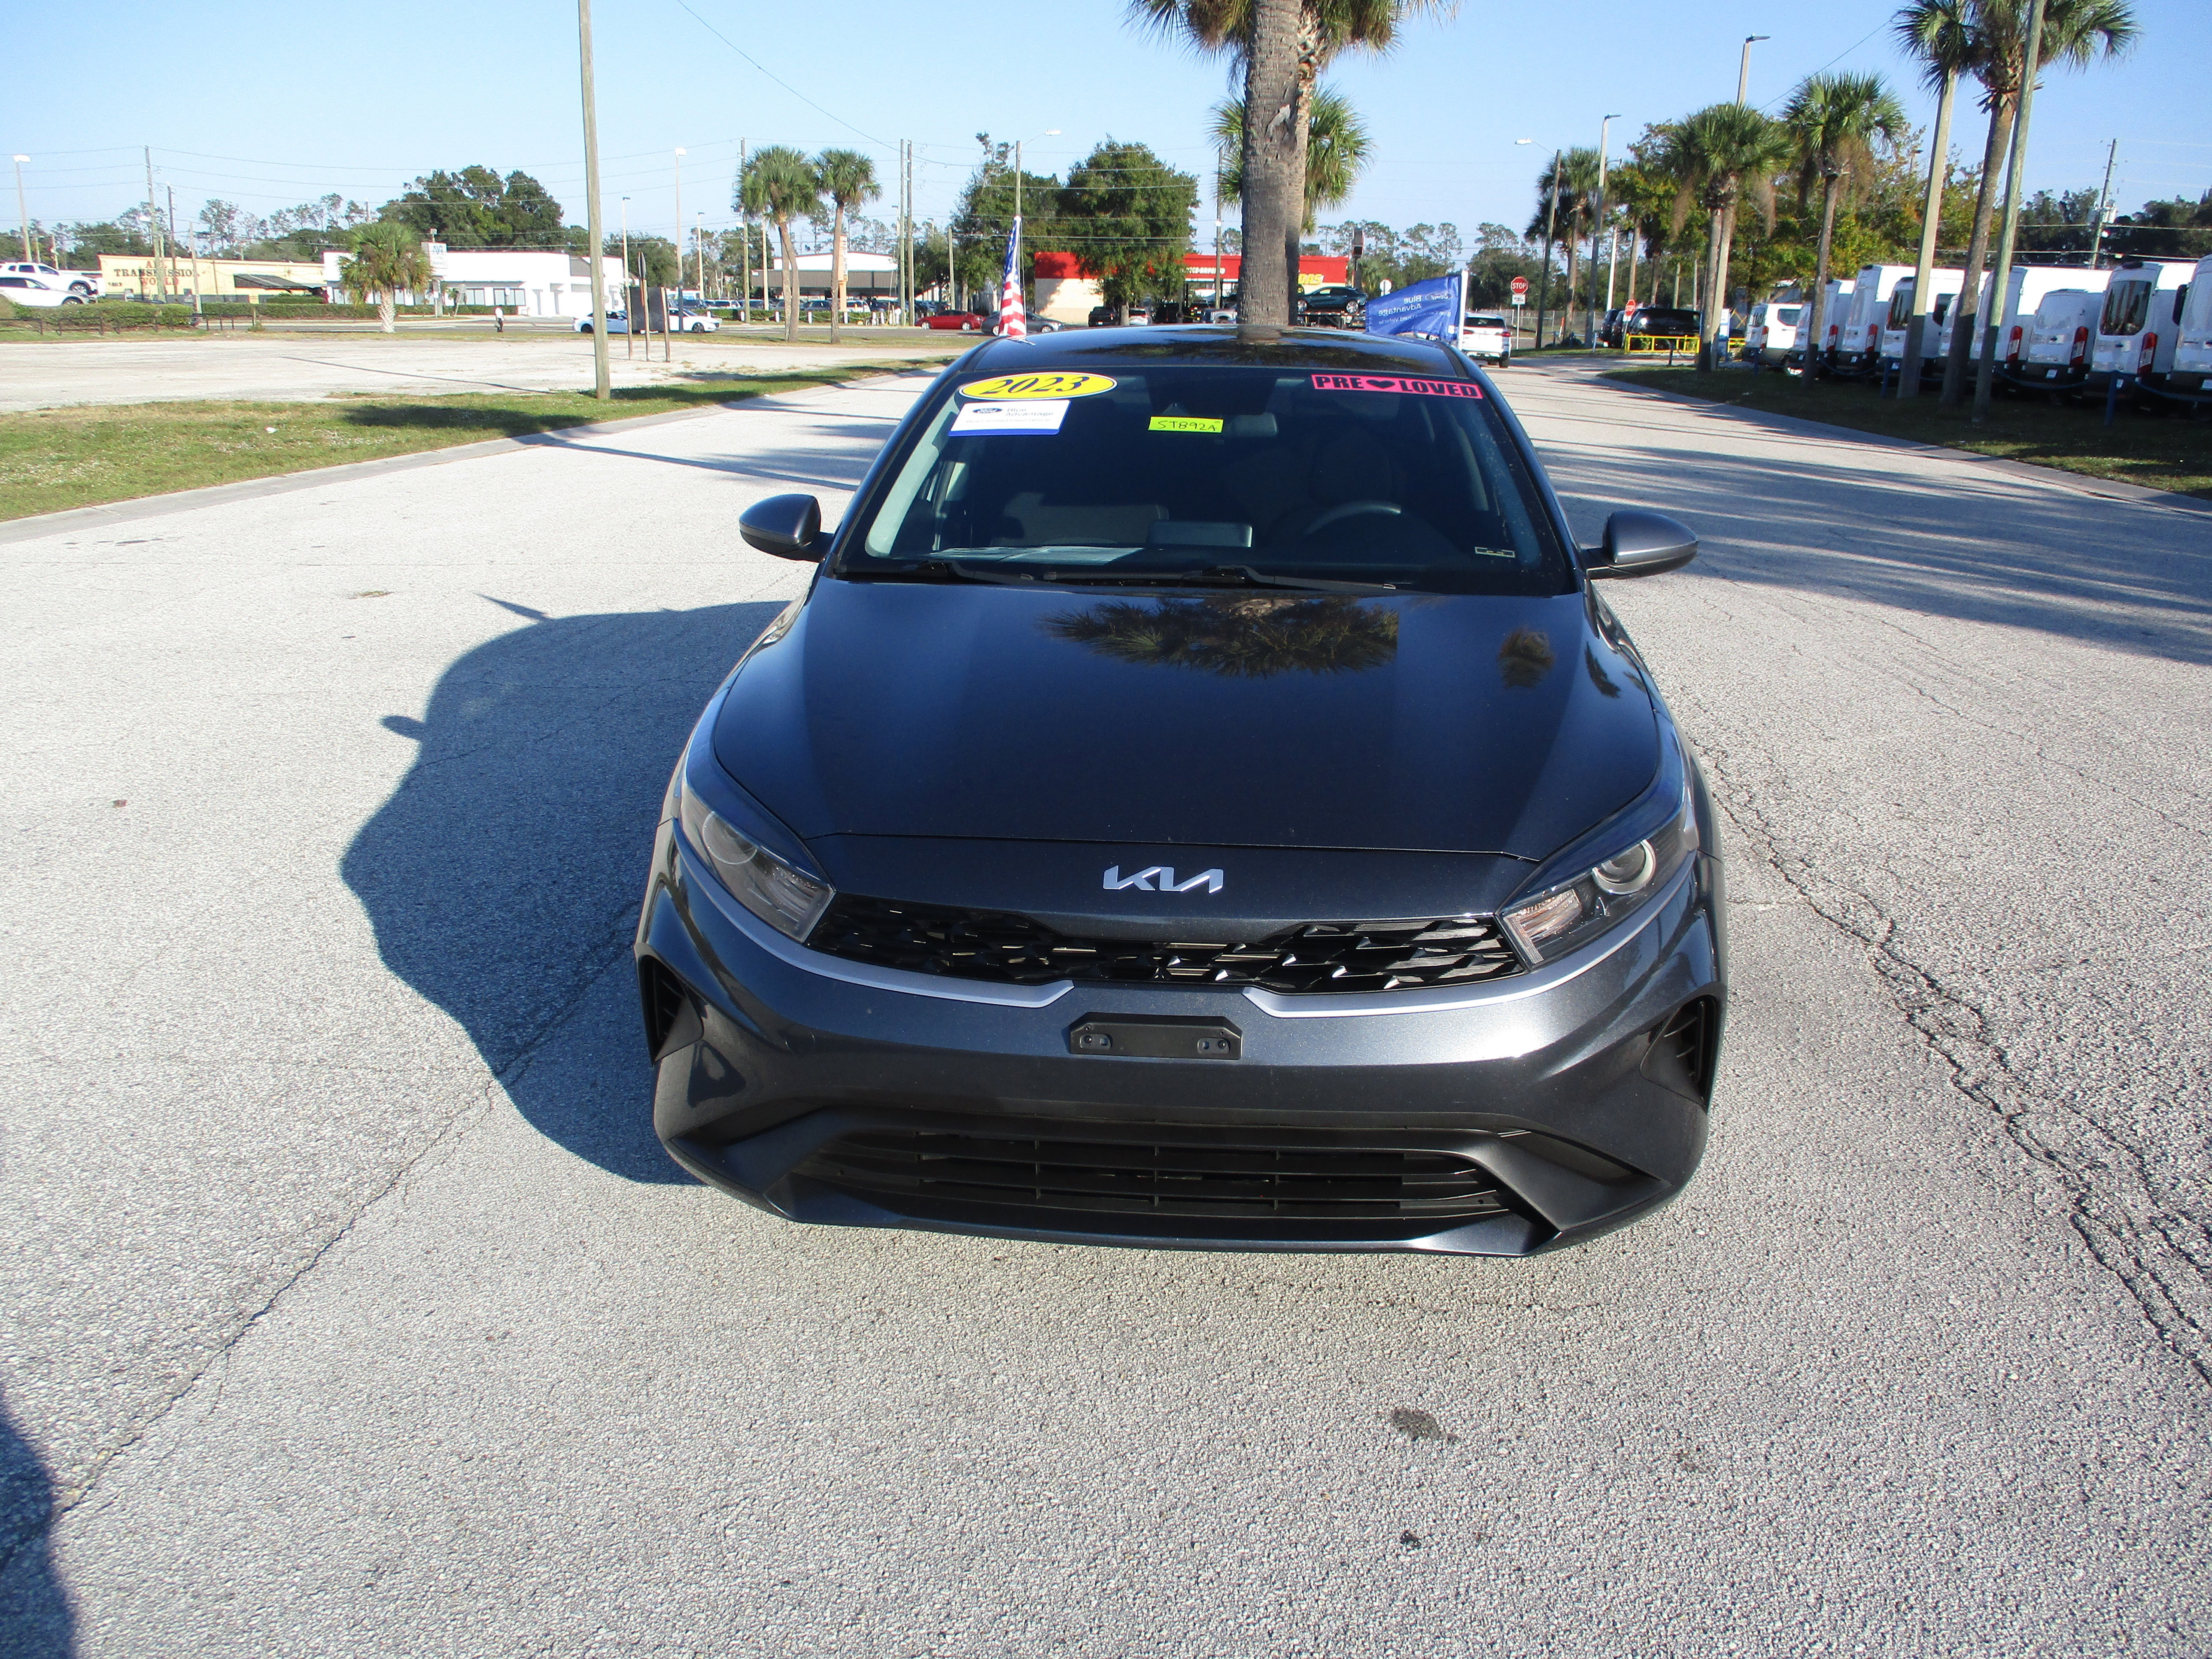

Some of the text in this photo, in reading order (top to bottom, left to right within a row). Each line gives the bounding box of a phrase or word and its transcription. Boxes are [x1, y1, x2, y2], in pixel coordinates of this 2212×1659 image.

[140, 277, 179, 286] WOLD
[1298, 273, 1323, 285] DAS
[978, 377, 1090, 395] 2023
[1315, 376, 1478, 397] PRE LOVED
[1103, 865, 1224, 893] KIA
